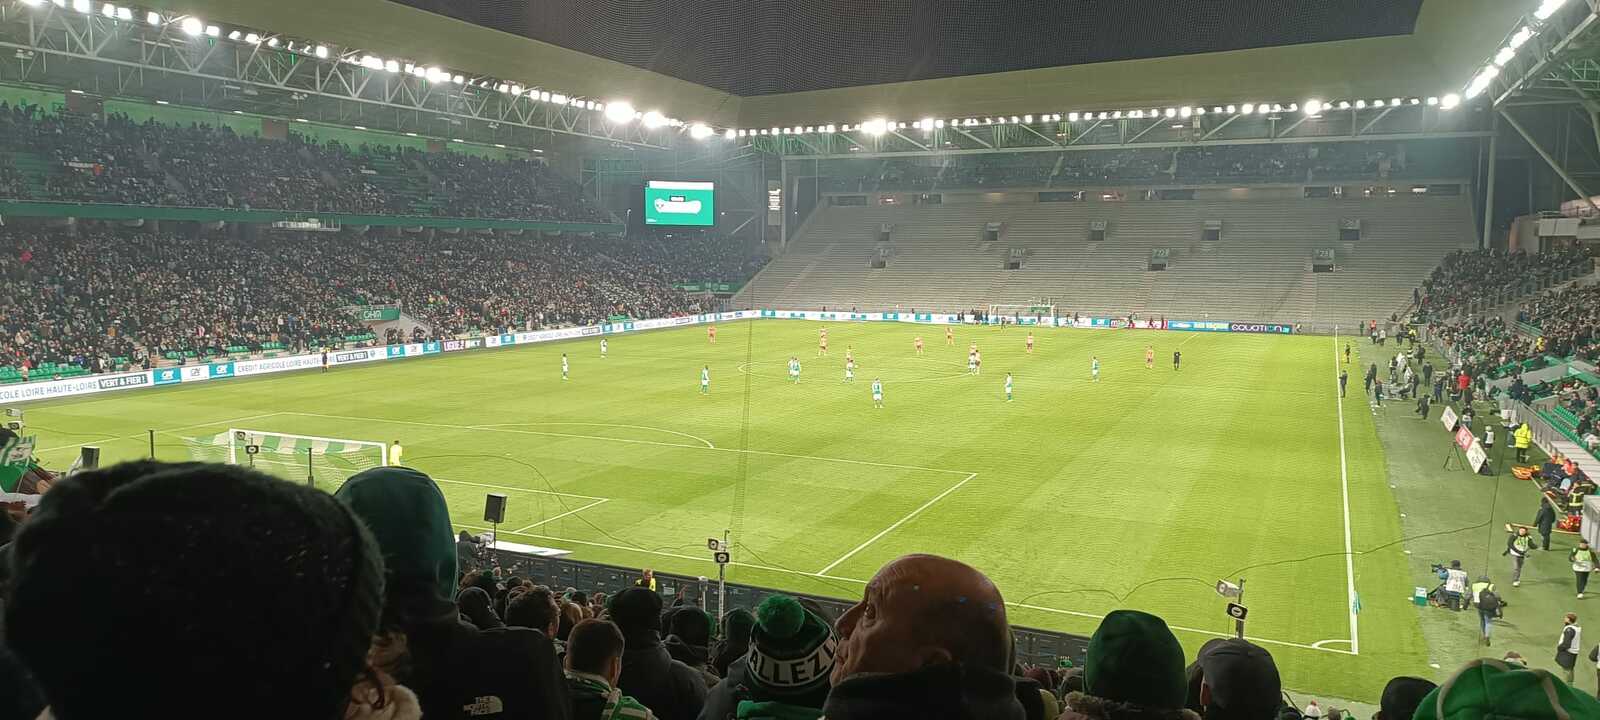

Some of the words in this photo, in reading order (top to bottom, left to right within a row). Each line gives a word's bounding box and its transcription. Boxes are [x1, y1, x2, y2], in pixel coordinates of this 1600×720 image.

[21, 388, 45, 398] LOIRE
[46, 381, 97, 394] HAUTE-LOIRE
[101, 379, 118, 388] VERT
[119, 378, 125, 386] &
[126, 376, 142, 386] FIER
